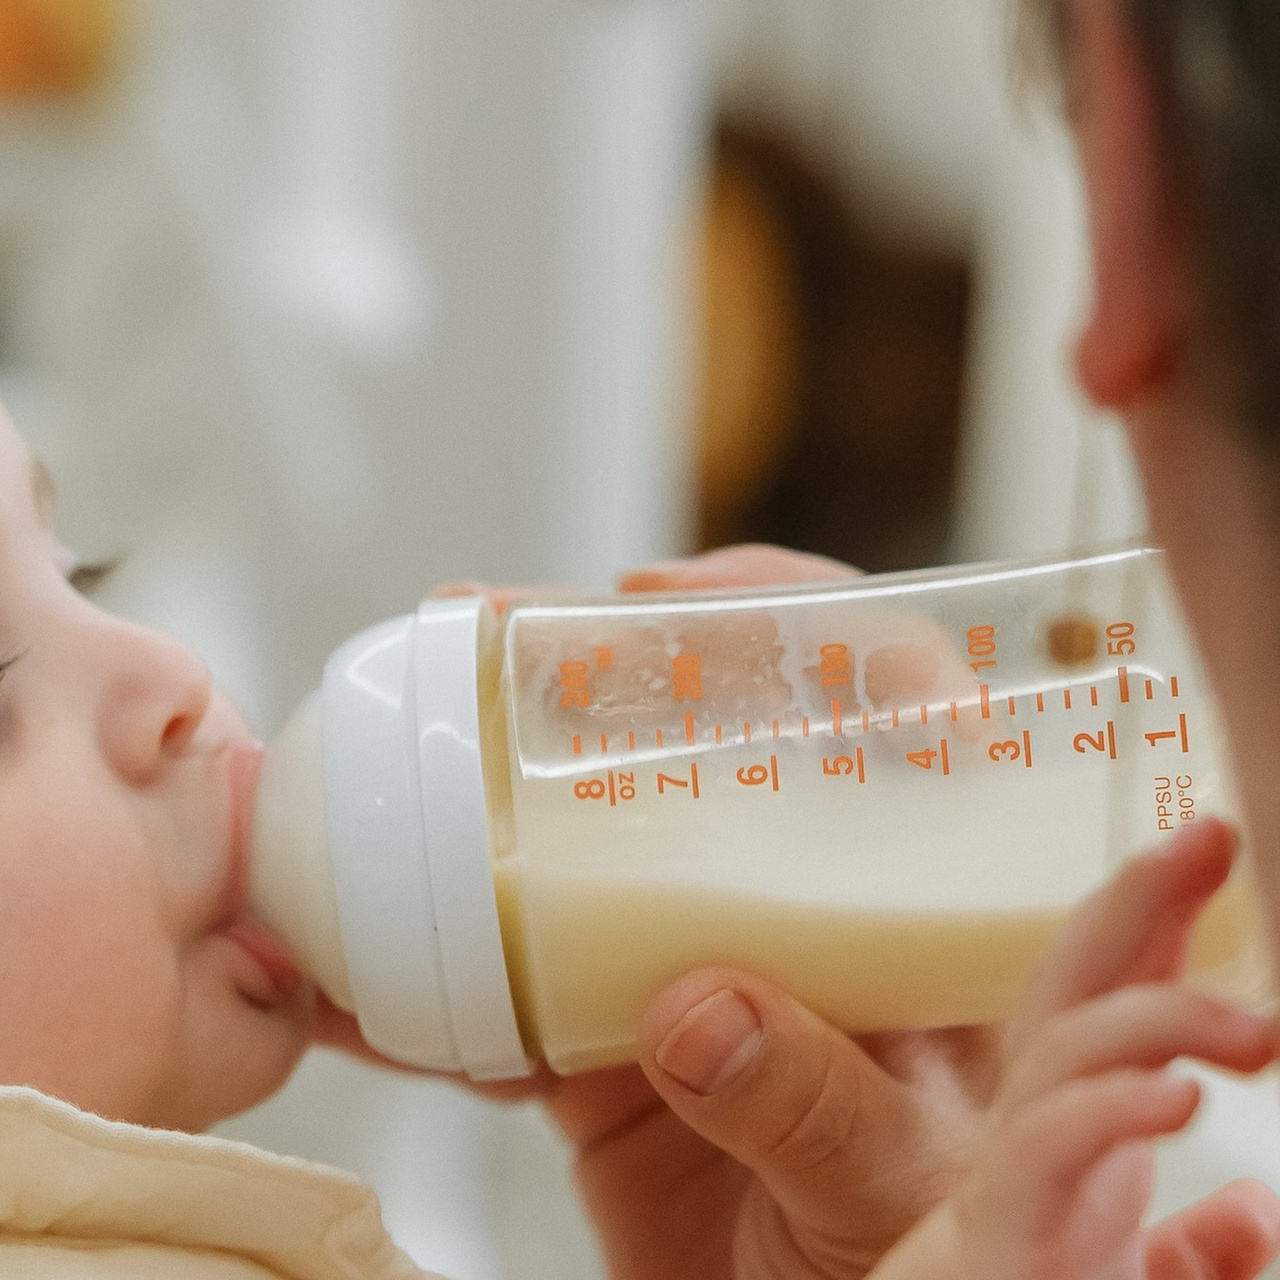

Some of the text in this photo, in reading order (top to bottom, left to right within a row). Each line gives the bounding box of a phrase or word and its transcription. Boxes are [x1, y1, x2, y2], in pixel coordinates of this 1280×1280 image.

[966, 625, 997, 673] 100
[1106, 621, 1136, 657] 50
[820, 643, 851, 688] 150
[988, 739, 1021, 762] 3
[1072, 730, 1105, 754] 2
[1144, 730, 1177, 748] 1
[822, 754, 854, 777] 5
[905, 747, 938, 770] 4
[618, 771, 636, 801] oz
[656, 772, 689, 795] 7
[736, 763, 768, 787] 6
[573, 778, 606, 801] 8
[1175, 774, 1196, 827] 80°C
[1154, 776, 1175, 831] PPSU
